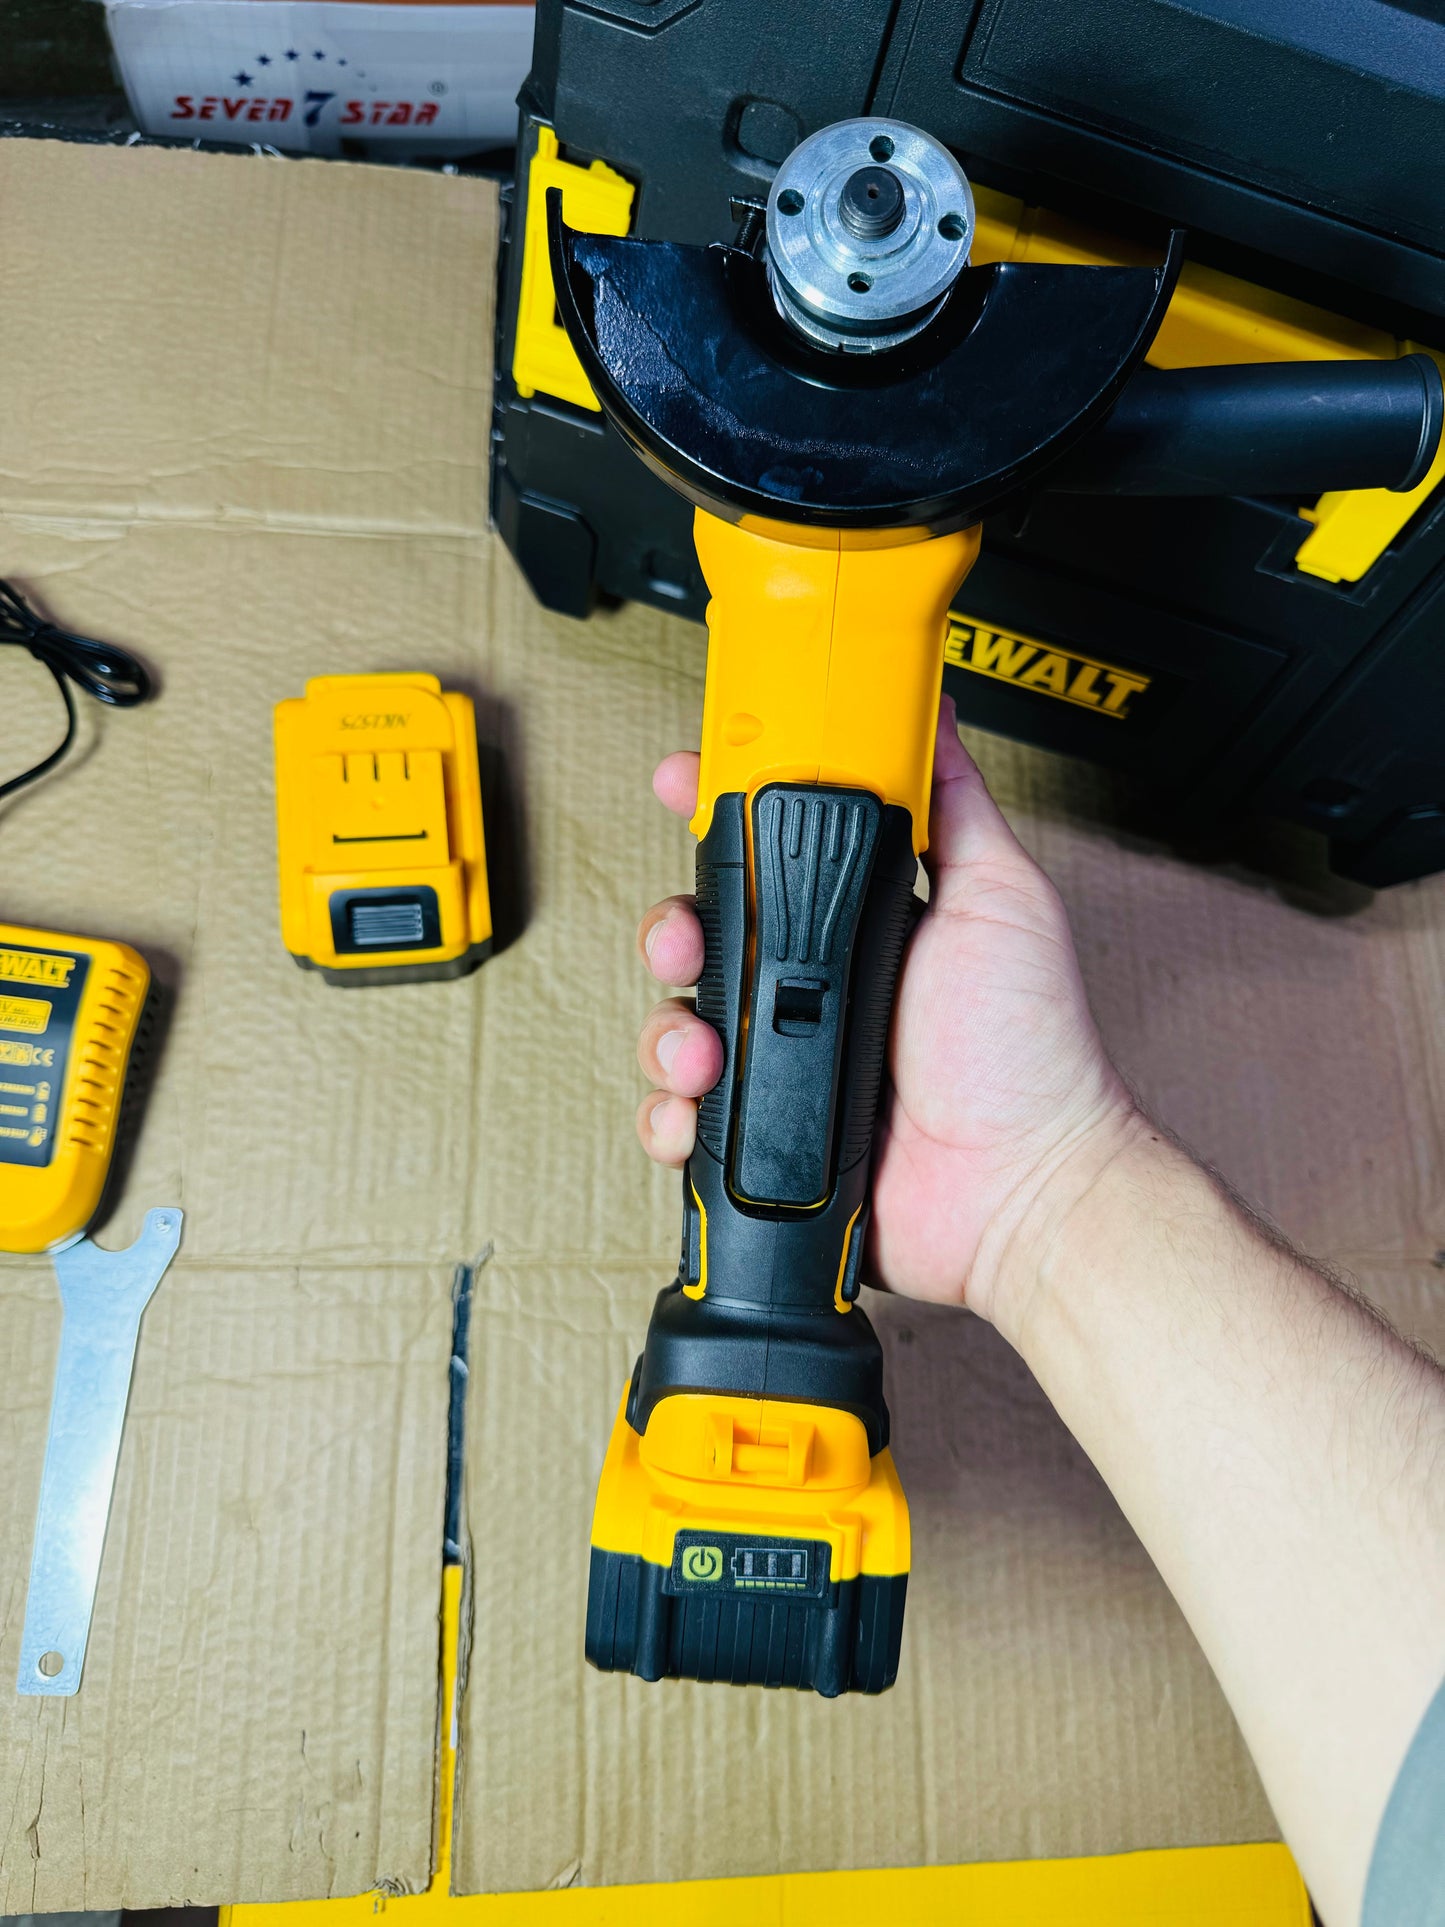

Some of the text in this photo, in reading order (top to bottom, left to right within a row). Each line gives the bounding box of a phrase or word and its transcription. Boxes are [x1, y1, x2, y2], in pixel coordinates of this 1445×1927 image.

[170, 90, 440, 127] SEVEN 7 STAR
[945, 624, 1148, 712] EWALT
[0, 953, 76, 982] WALT
